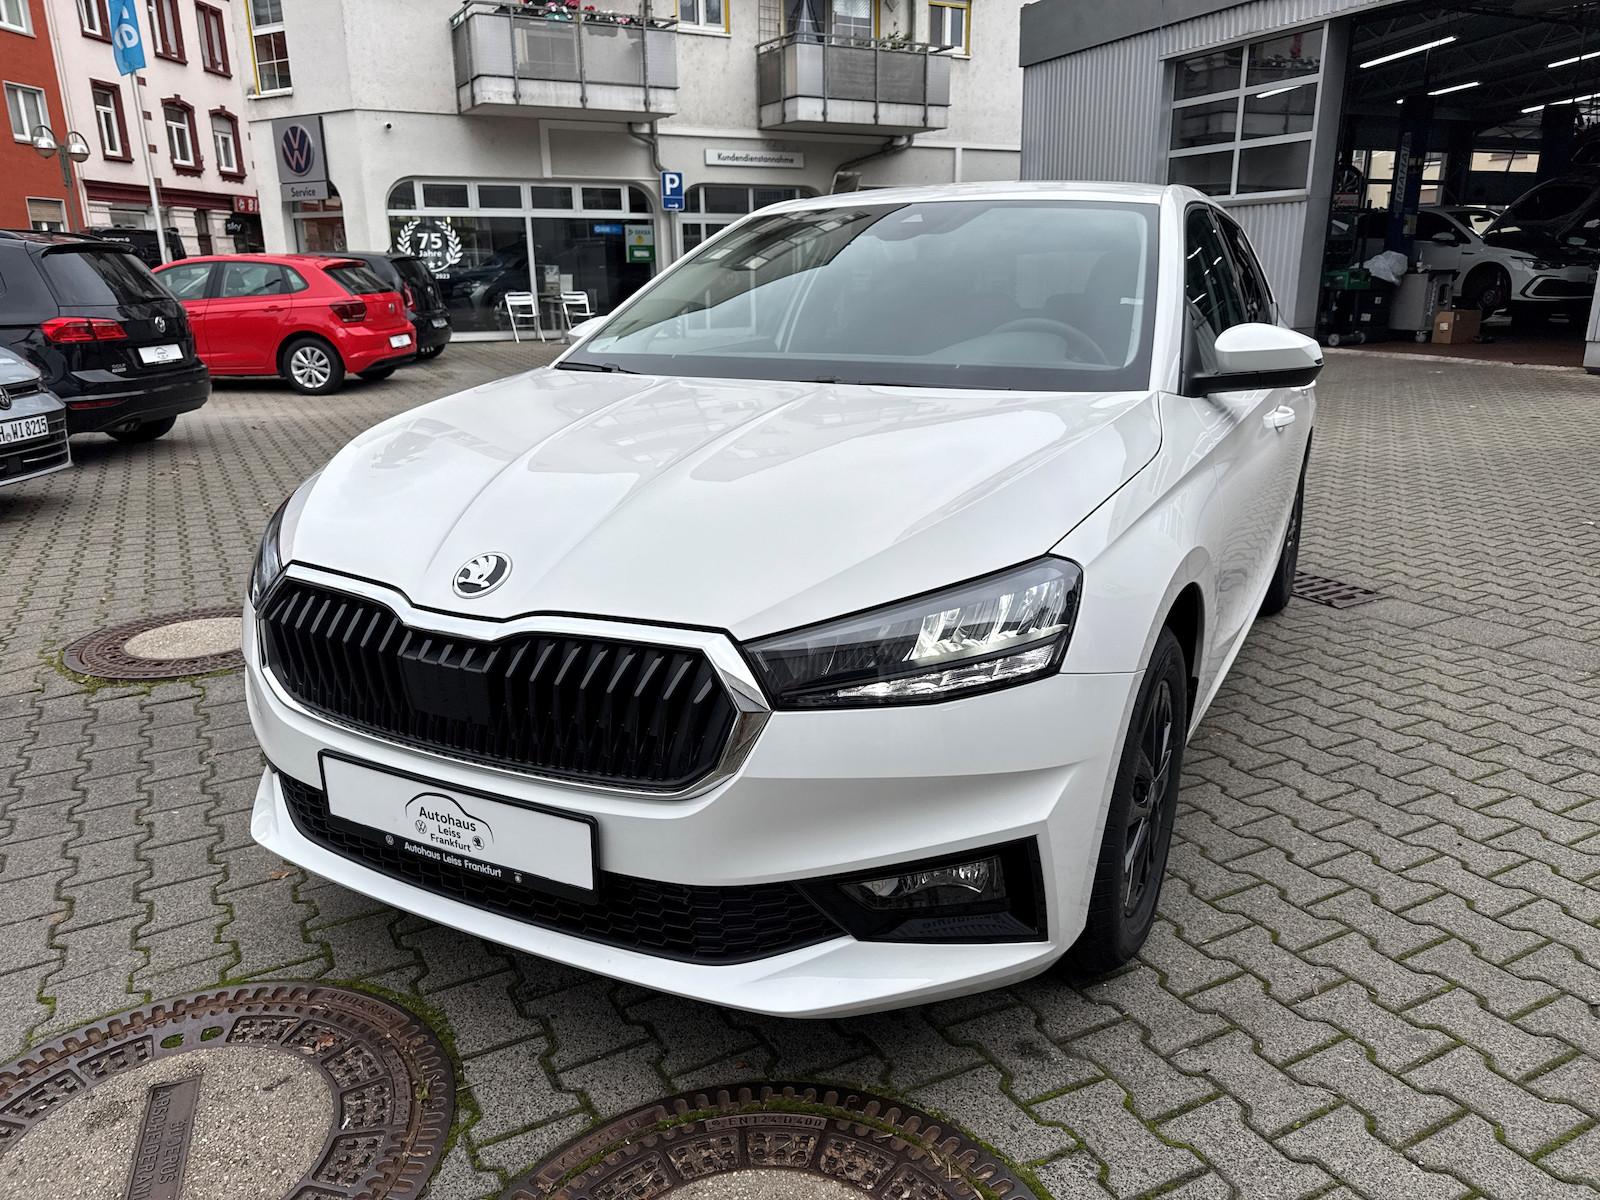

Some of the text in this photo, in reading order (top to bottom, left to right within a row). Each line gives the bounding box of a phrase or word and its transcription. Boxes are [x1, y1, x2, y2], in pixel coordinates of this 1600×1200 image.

[290, 186, 316, 198] Service
[665, 174, 680, 195] P
[227, 222, 242, 232] sky
[416, 232, 442, 249] 75
[419, 249, 442, 258] Jahre
[25, 417, 48, 437] 8215
[419, 806, 477, 832] Autohaus
[438, 824, 461, 839] Leiss
[430, 833, 471, 853] Frankfurt
[404, 841, 502, 878] Autohaus Leiss Frankfurt
